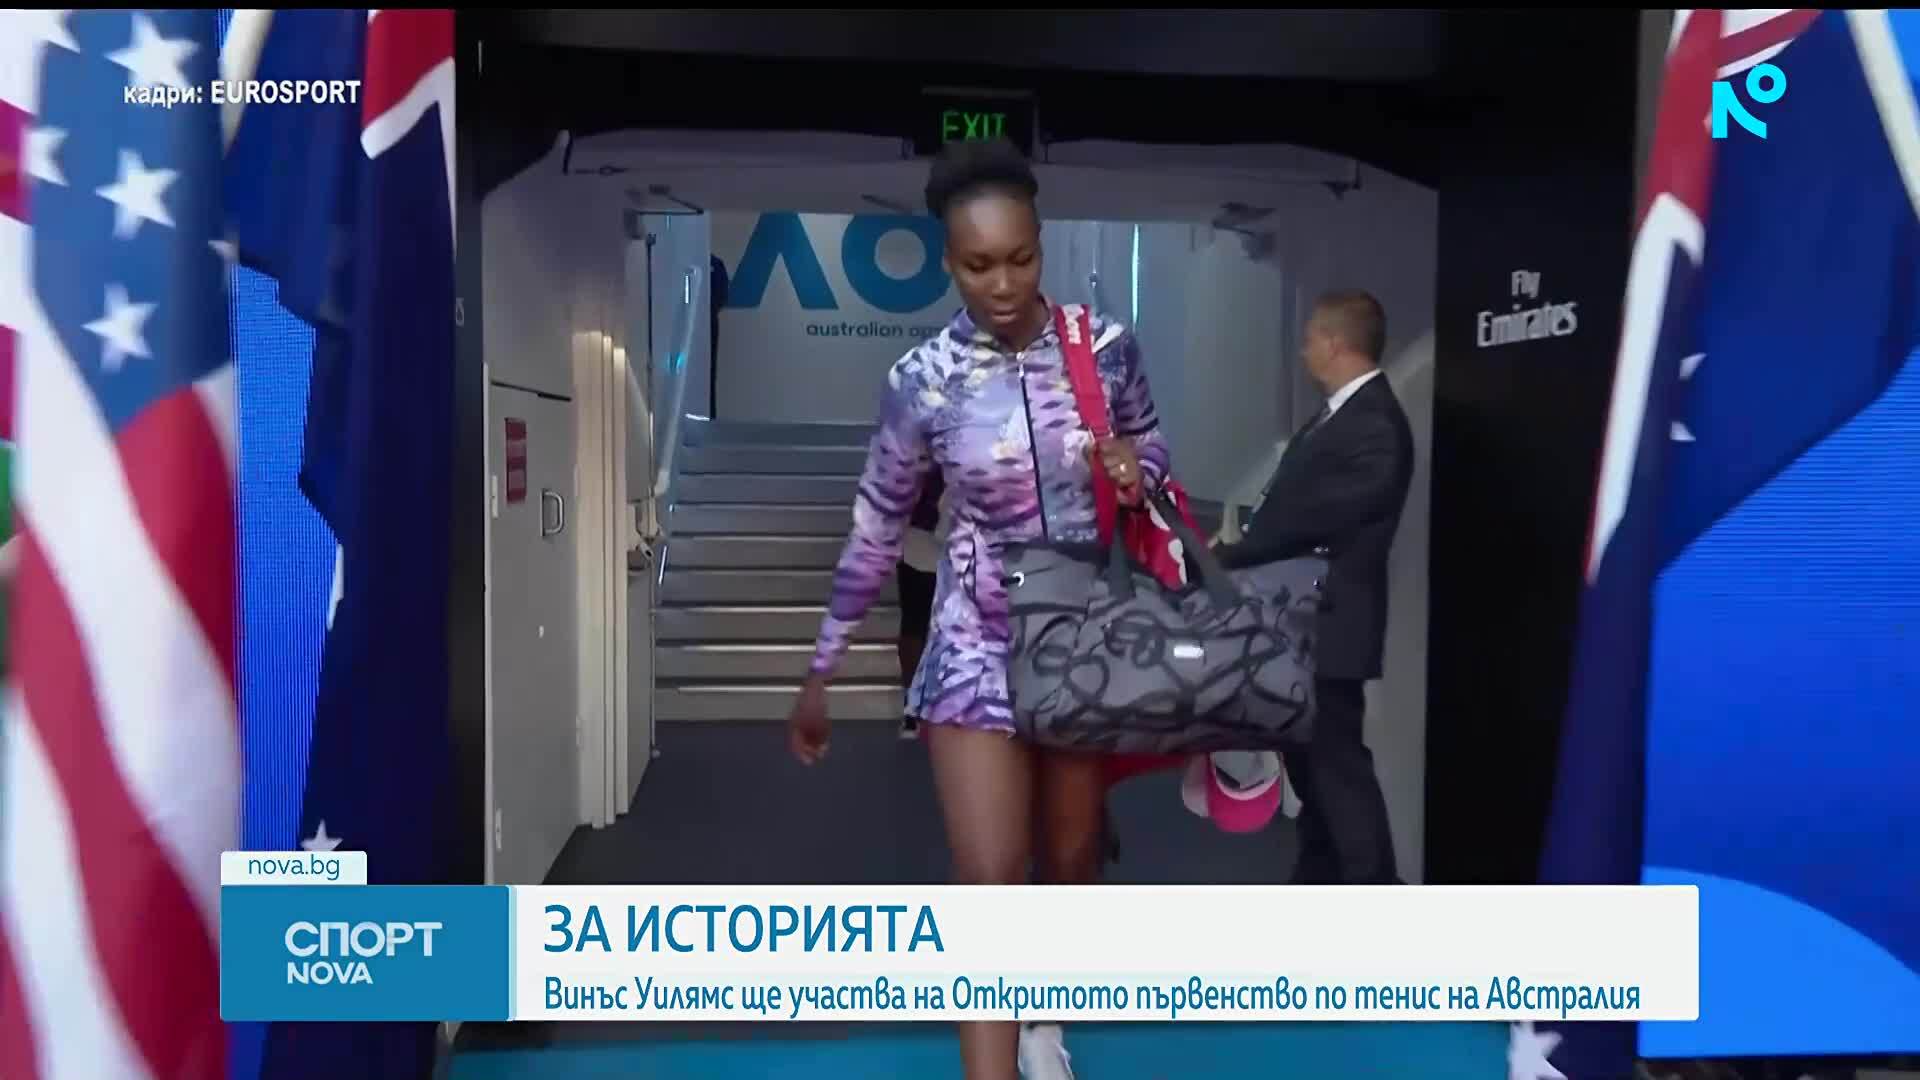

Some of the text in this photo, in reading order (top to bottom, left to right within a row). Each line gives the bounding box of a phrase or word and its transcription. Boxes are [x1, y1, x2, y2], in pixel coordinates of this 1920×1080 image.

[942, 110, 1006, 144] EXIT
[1511, 269, 1541, 299] Fly
[806, 321, 902, 337] australian
[1477, 301, 1578, 348] Emirates
